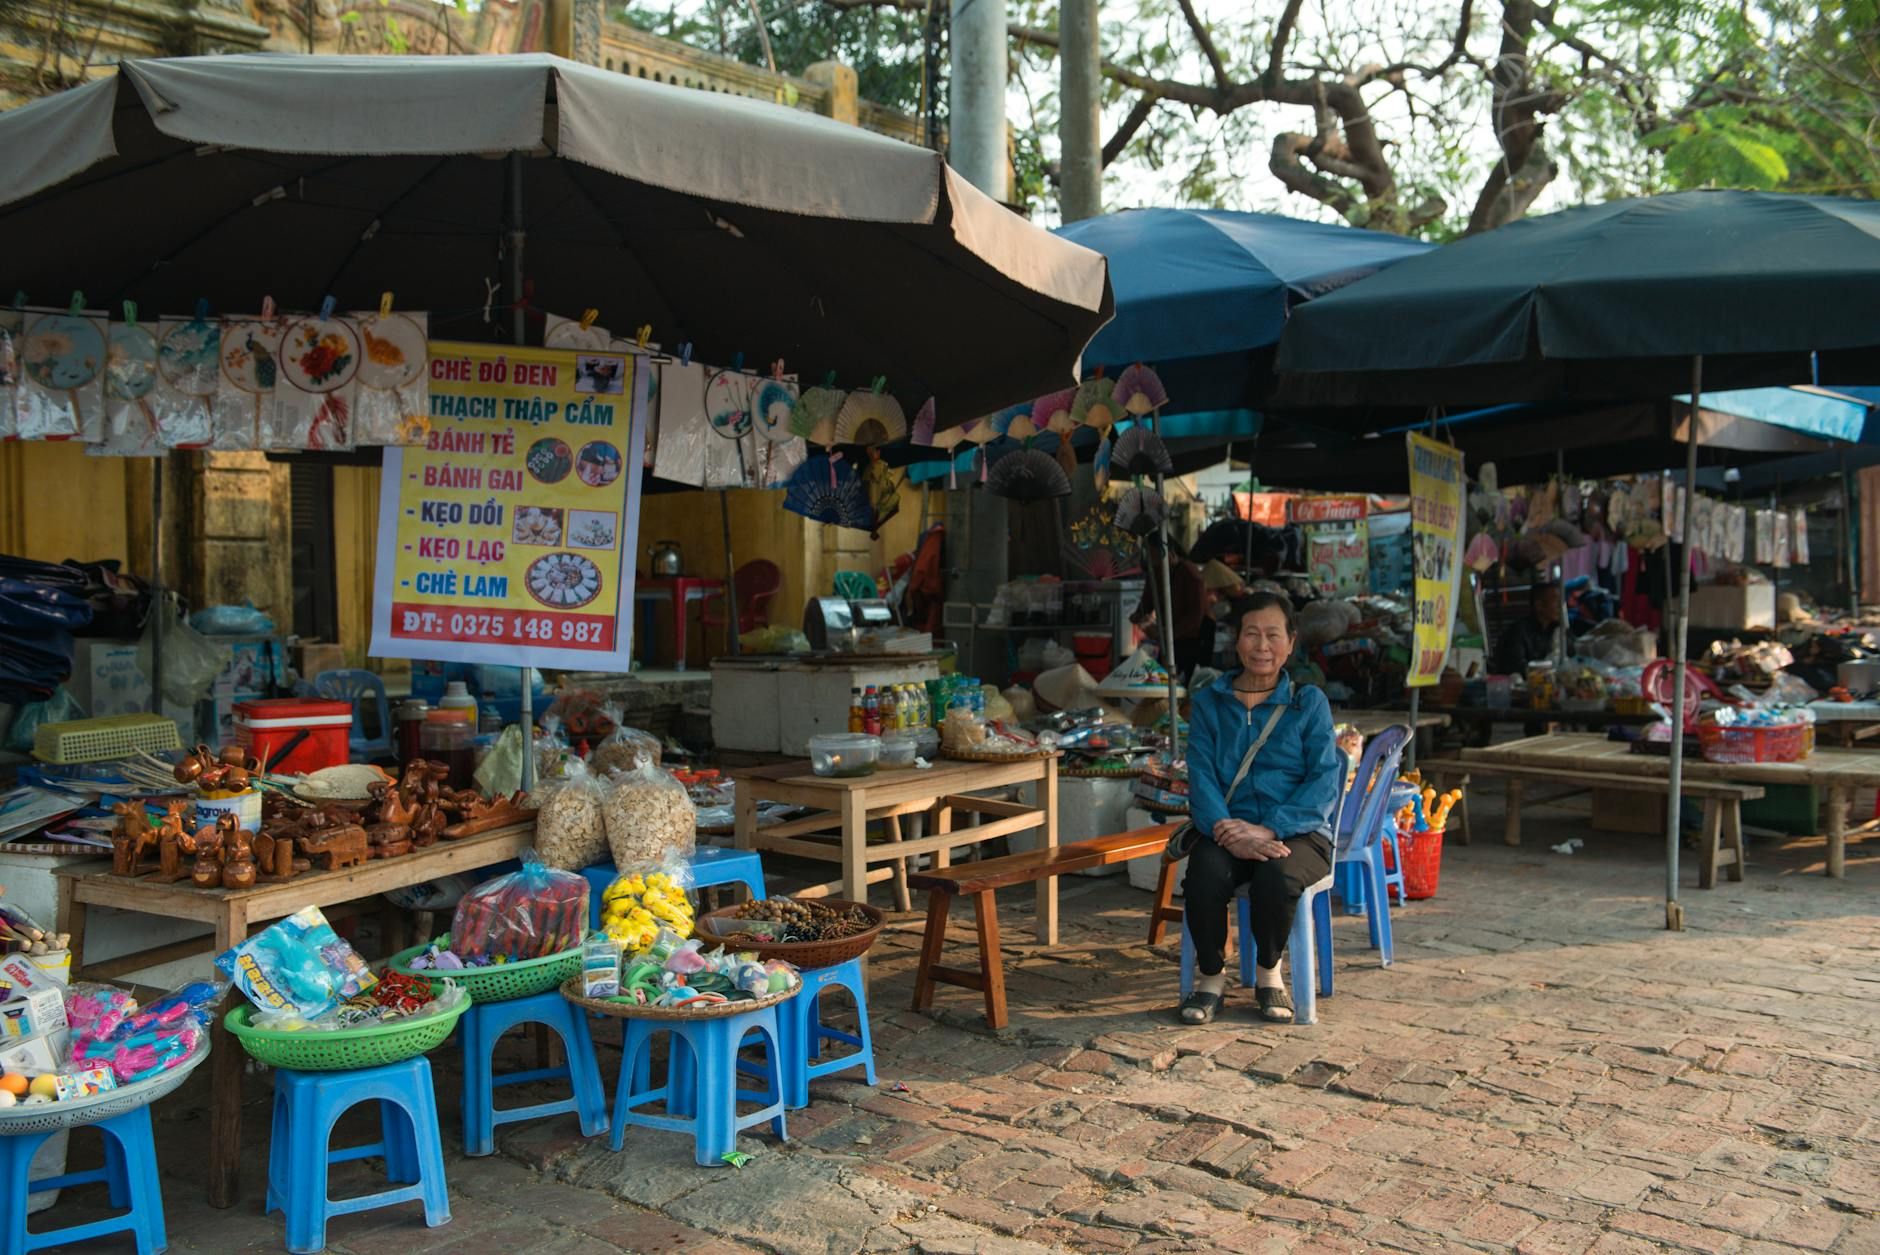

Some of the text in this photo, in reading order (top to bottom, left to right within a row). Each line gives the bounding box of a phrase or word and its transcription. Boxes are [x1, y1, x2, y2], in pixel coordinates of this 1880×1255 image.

[431, 356, 472, 382] CHÈ
[513, 363, 557, 387] ĐEN
[429, 394, 614, 426] THẠCH THẬP CẨM
[426, 426, 514, 455] BÁNH TẺ
[424, 462, 482, 489] BÁNH
[488, 469, 523, 492] GAI
[421, 501, 463, 527] KẸO
[419, 537, 460, 563] KẸO
[467, 539, 505, 565] LẠC
[416, 569, 457, 594] CHÈ
[463, 575, 508, 598] LAM
[403, 611, 603, 643] ĐT: 0375 148 987
